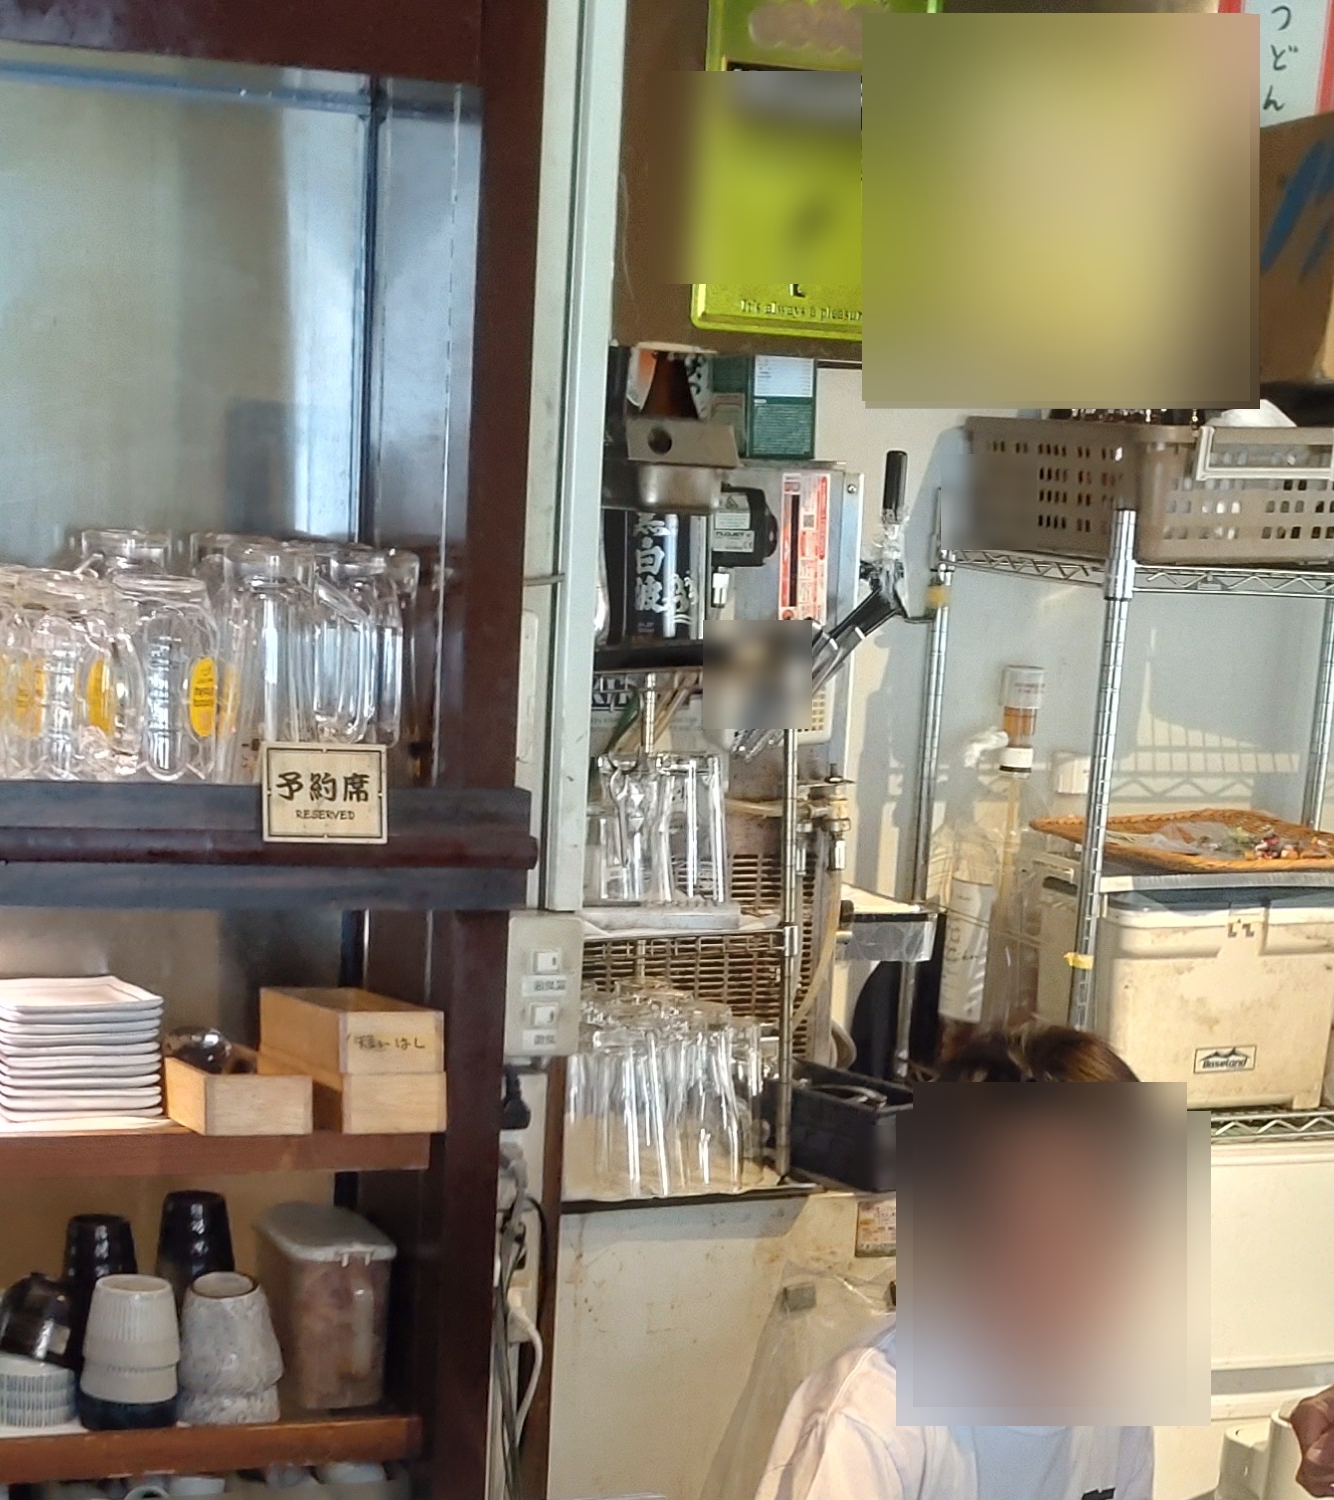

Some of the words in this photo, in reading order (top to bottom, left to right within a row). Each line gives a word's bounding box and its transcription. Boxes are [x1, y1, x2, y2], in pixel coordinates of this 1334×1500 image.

[275, 771, 371, 803] 予約席
[294, 808, 356, 821] RESERVED
